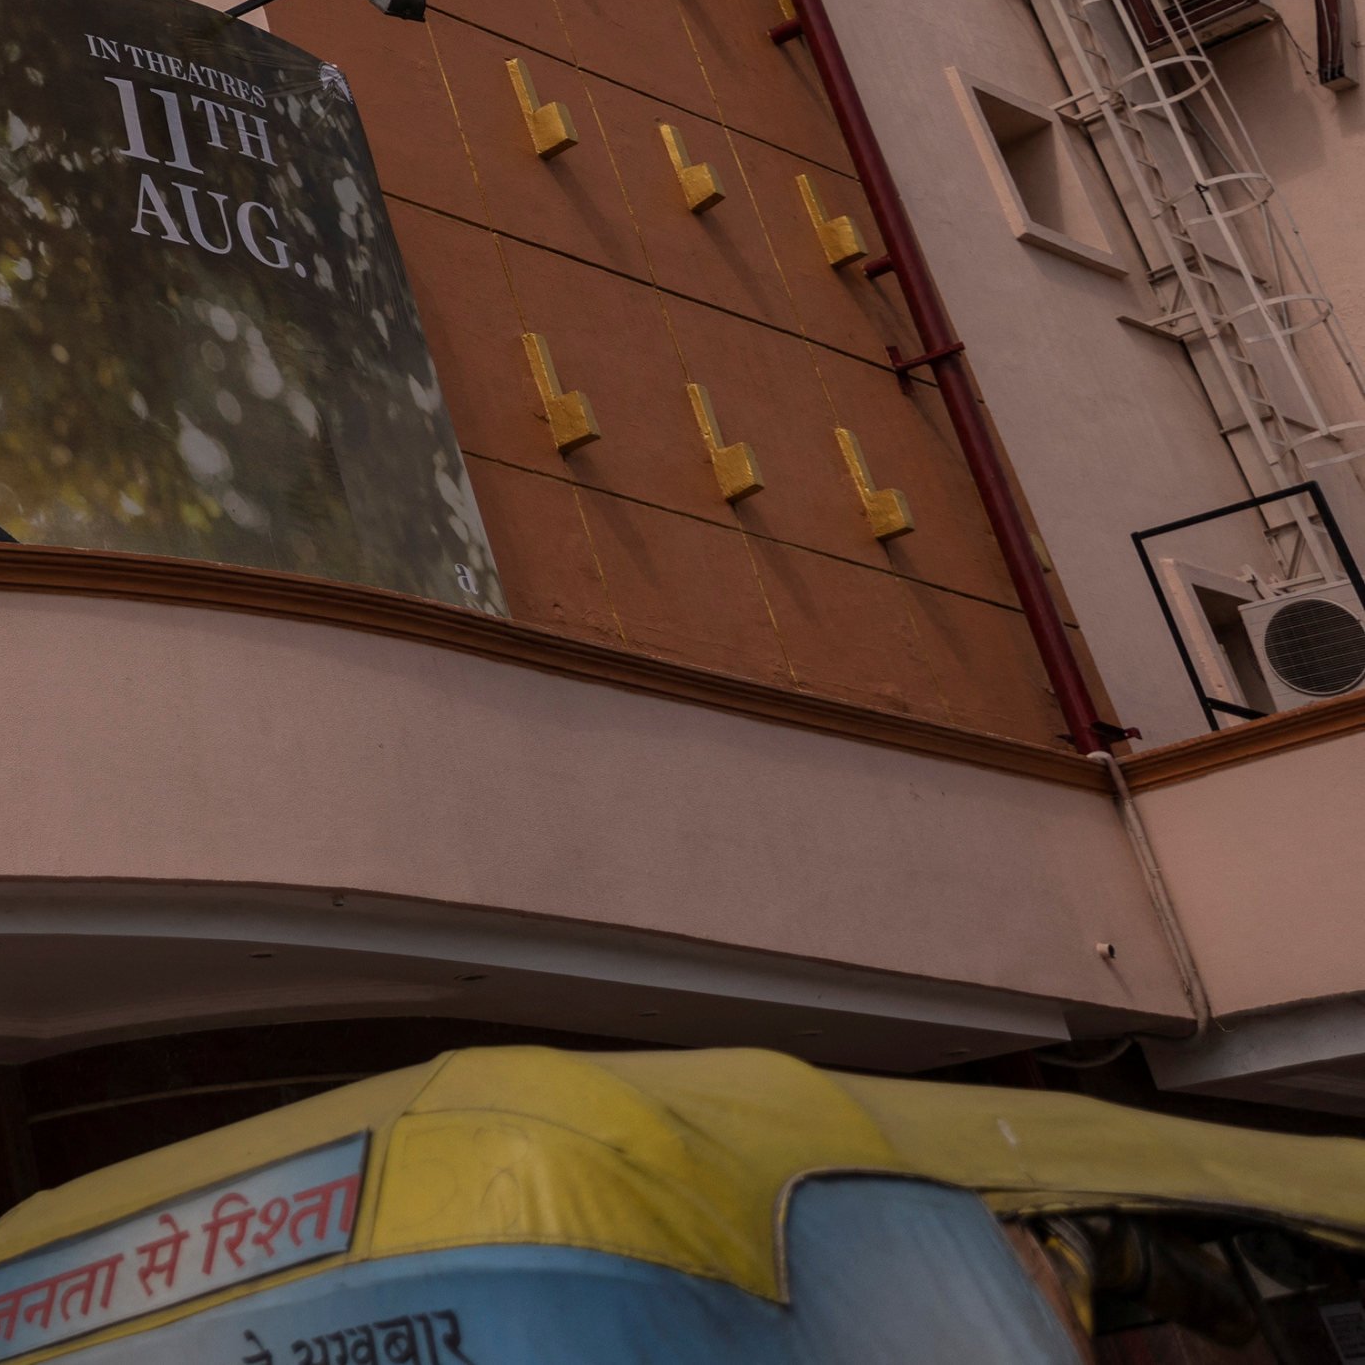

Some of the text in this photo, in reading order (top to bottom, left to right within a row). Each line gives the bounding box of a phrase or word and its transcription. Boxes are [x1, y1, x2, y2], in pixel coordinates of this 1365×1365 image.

[84, 34, 267, 109] IN THEATRES
[104, 76, 279, 175] 11TH
[131, 173, 307, 279] AUG.
[134, 1212, 191, 1298] से
[201, 1171, 361, 1275] रिश्ता
